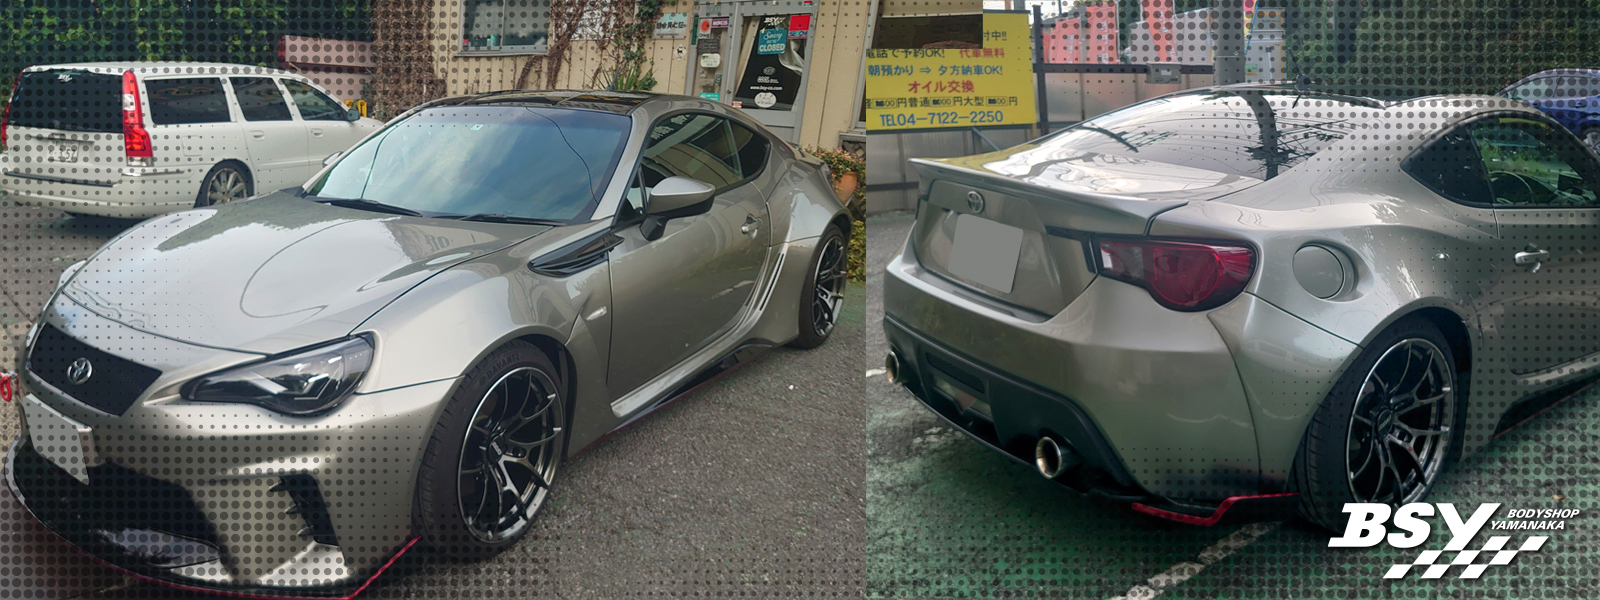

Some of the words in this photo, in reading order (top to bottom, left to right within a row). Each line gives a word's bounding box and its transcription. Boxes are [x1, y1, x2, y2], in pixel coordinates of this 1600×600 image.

[763, 31, 783, 40] Sorry
[759, 43, 785, 52] CLOSED
[959, 47, 1005, 58] 代車無料
[868, 65, 914, 76] 朝預かり
[938, 65, 1003, 76] 夕方納車OK!
[908, 80, 975, 94] オイル交換
